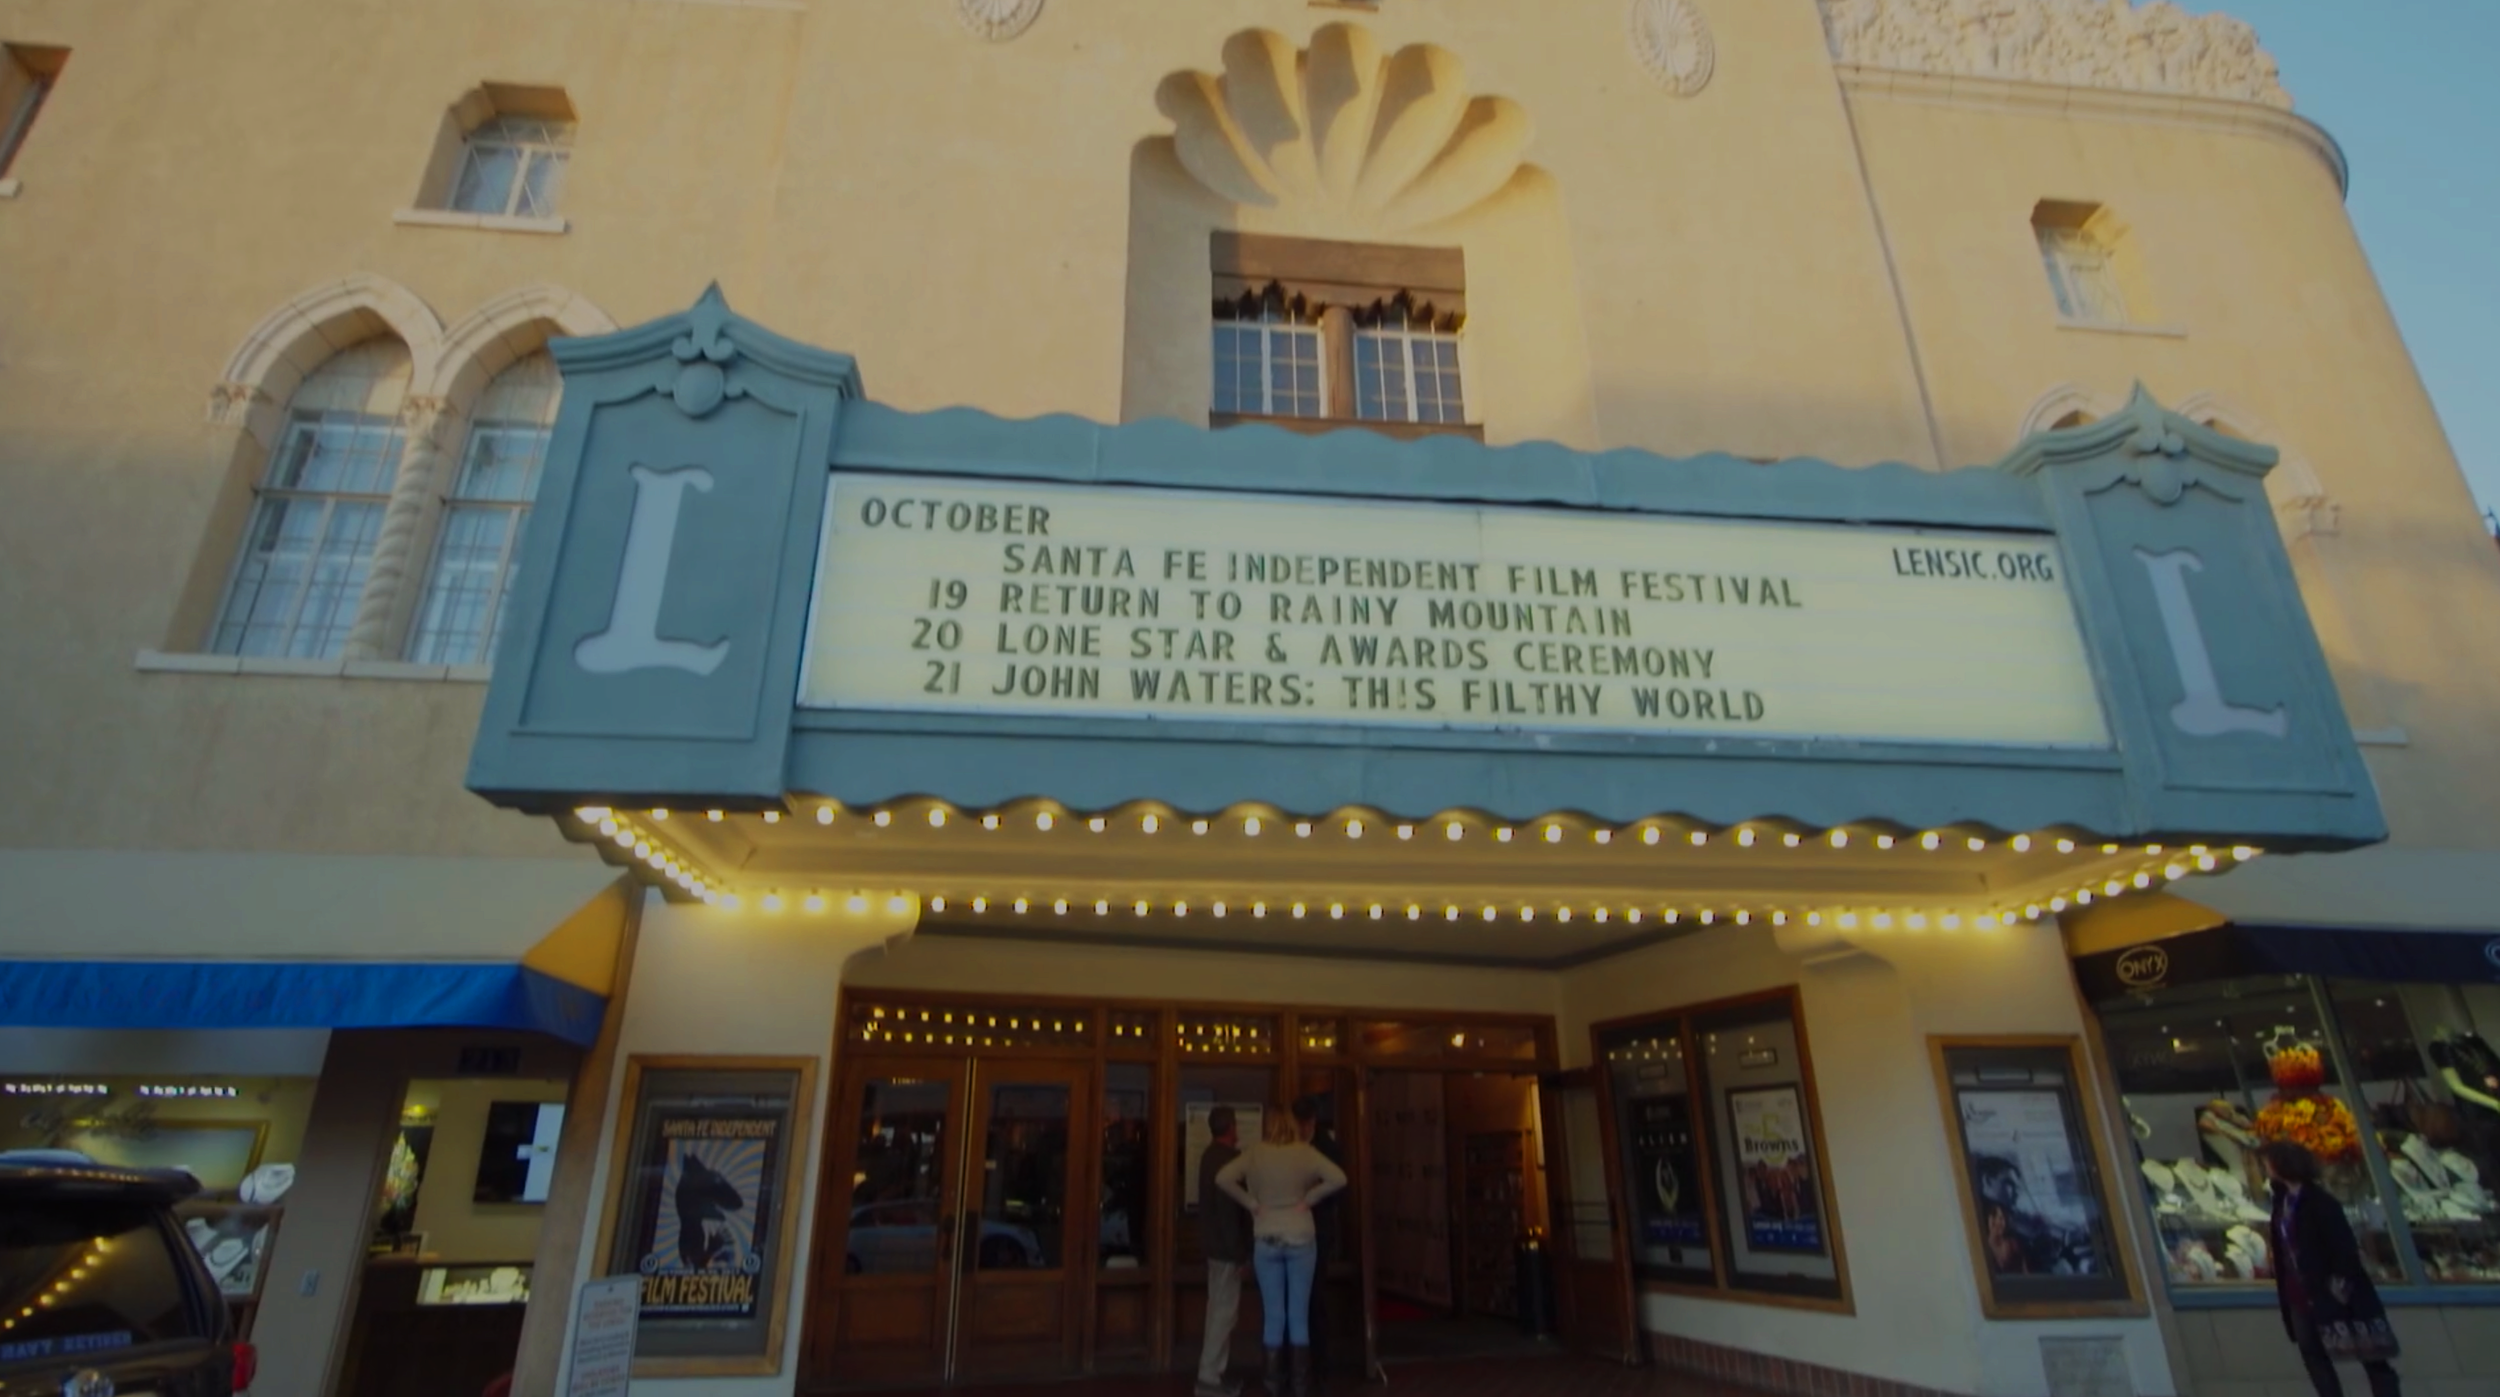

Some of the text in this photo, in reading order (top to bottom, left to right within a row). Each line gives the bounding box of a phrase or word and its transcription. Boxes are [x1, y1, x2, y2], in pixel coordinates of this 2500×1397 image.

[859, 497, 1051, 536] OCTOBER
[1002, 542, 1803, 608] SANTA FE INDEPENDENT FILM FESTIVAL
[1891, 546, 2055, 582] LENSIC.ORG
[928, 578, 1633, 637] 19 RETURN TO RAINY MOUNTAIN
[910, 617, 1715, 680] 20 LONE STAR & AWARDS CEREMONY
[922, 659, 1766, 722] 21 JOHN WATERS: THIS FILTHY WORLD
[2119, 953, 2166, 979] ONYX
[662, 1118, 694, 1138] SANTA
[1744, 1137, 1799, 1153] Browns
[641, 1273, 754, 1304] FILM FESTIVAL
